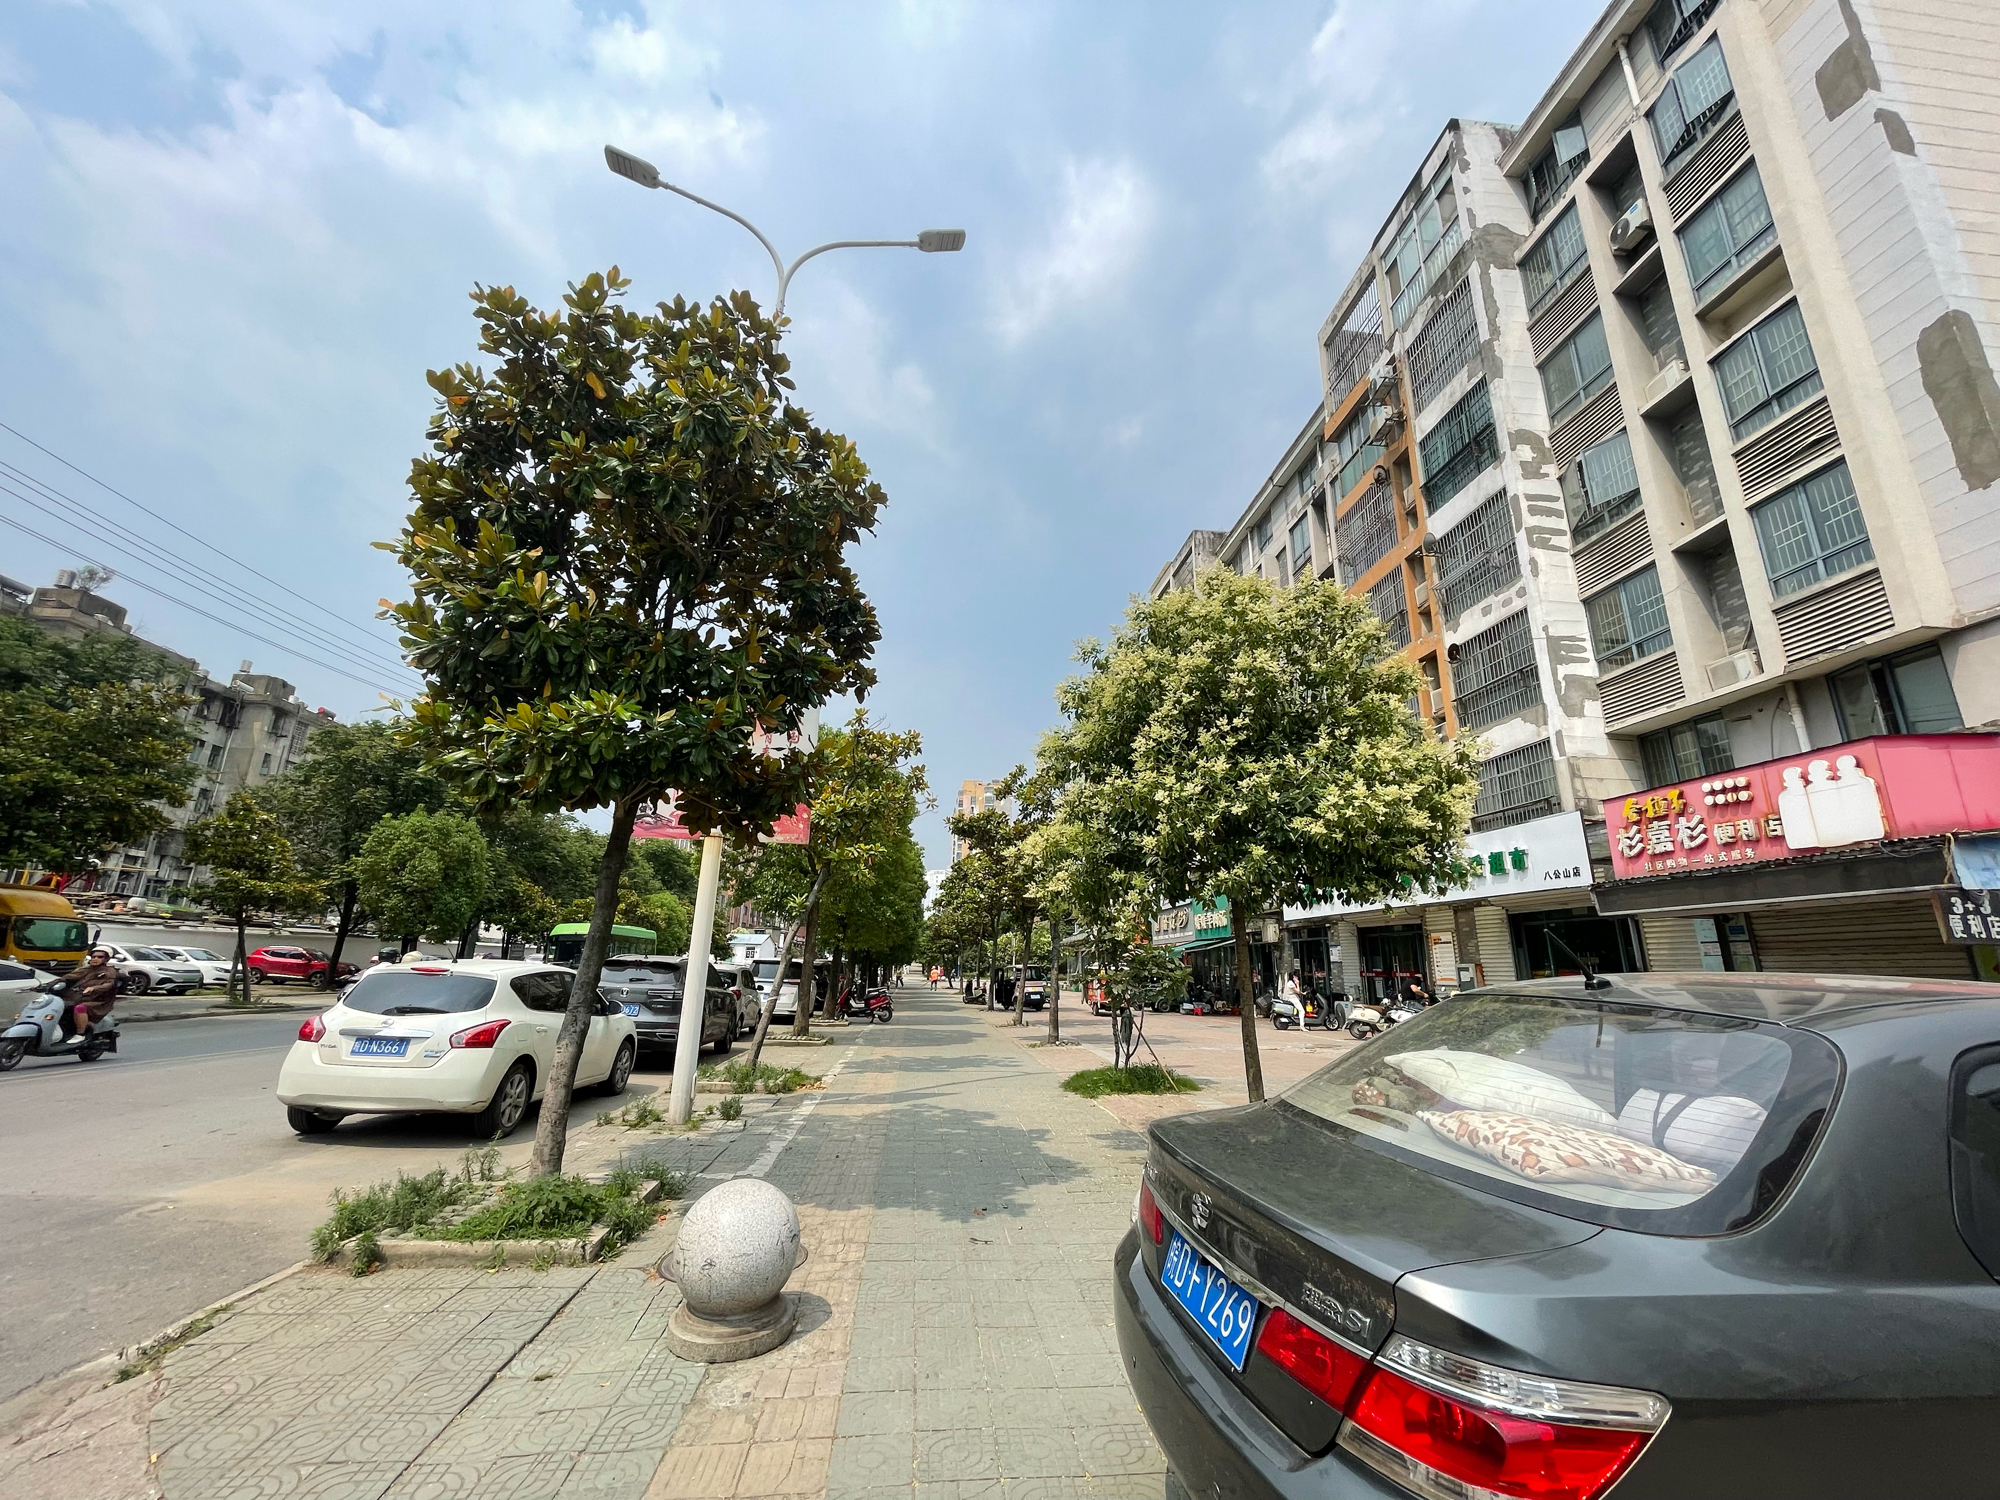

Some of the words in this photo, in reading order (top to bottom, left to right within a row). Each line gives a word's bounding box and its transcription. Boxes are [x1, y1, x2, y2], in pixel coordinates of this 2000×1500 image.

[1644, 848, 1755, 871] 社区购物一站式服务
[1544, 866, 1581, 880] 八公山店
